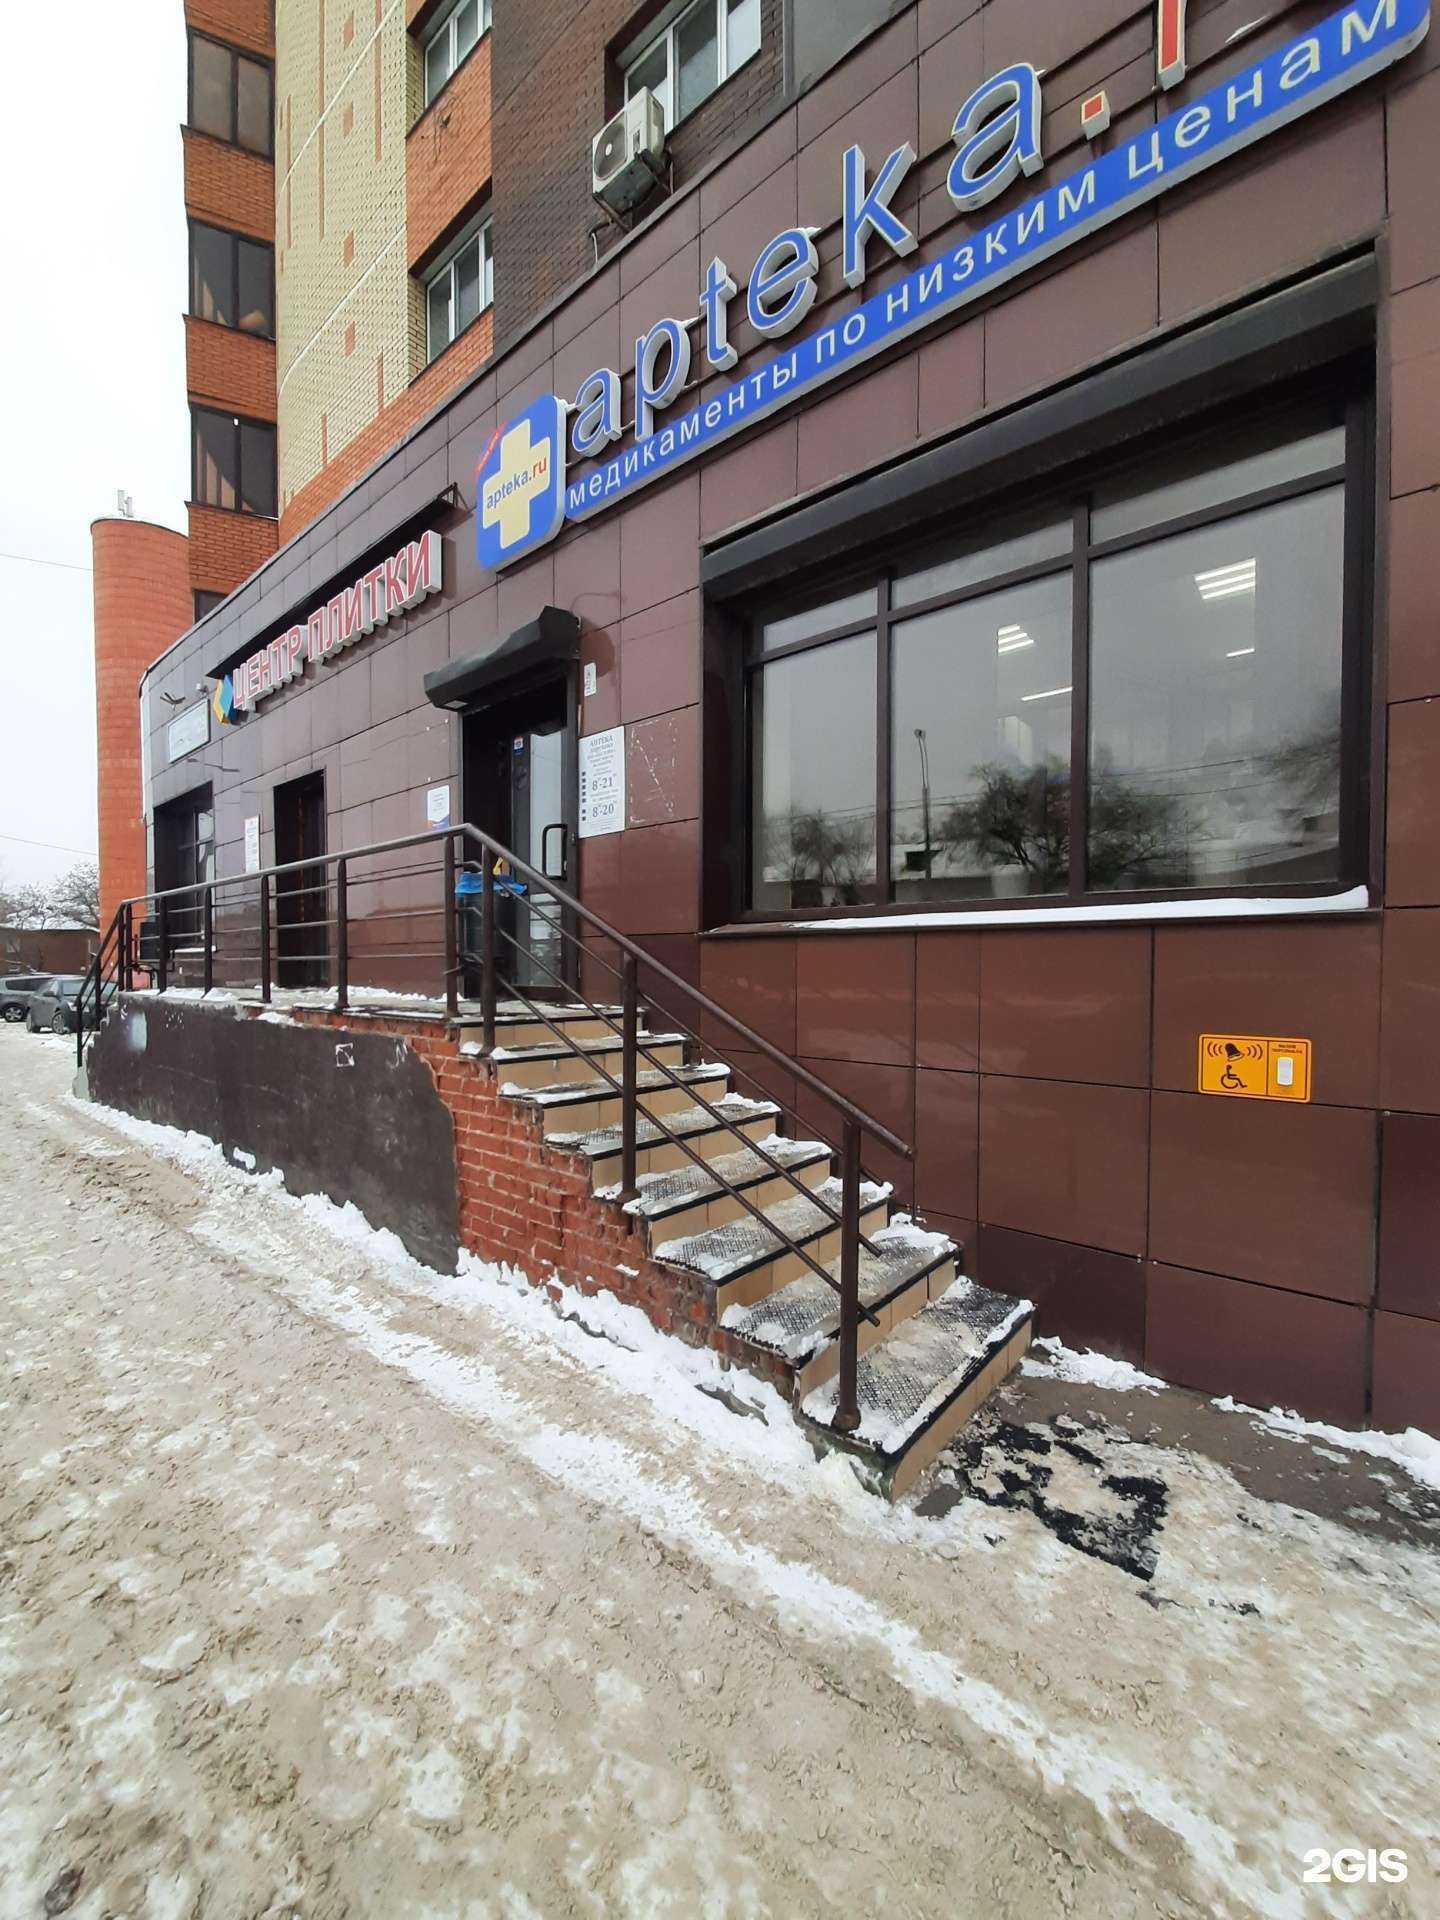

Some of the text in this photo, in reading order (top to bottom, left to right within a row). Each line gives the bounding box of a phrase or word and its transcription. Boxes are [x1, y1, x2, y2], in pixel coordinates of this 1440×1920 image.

[568, 0, 1398, 510] медикаменты по низким ценам
[486, 456, 548, 511] apteka.ru
[232, 529, 441, 713] ЦЕНТР ПЛИТКИ
